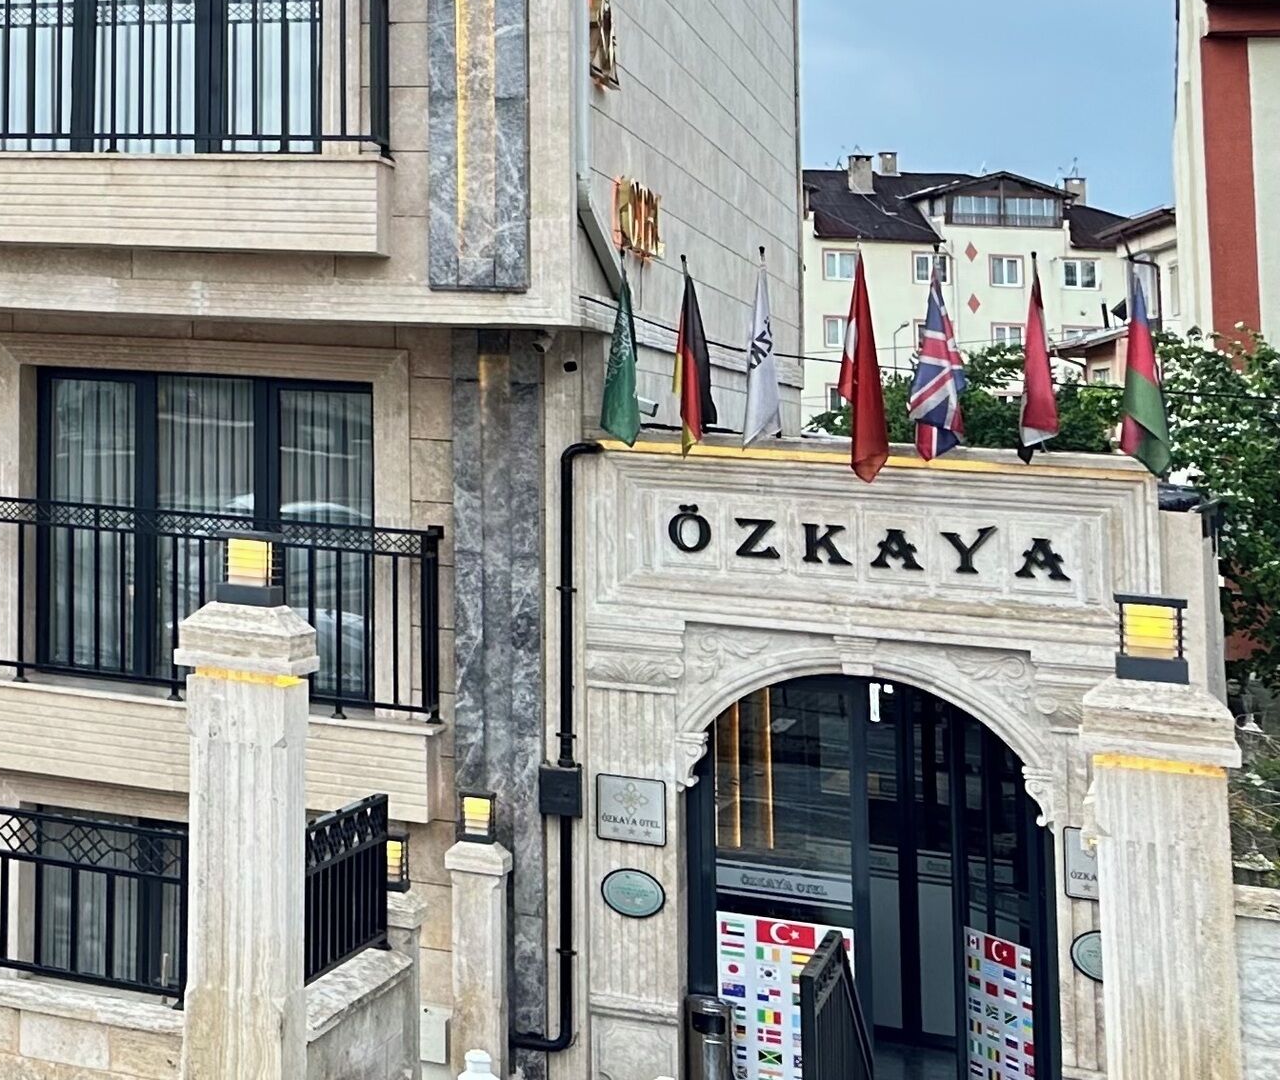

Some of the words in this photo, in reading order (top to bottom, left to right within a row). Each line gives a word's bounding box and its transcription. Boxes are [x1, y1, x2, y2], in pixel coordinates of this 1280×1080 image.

[668, 504, 1071, 581] ÖZKAYA
[601, 812, 638, 826] ÖZKAYA
[639, 818, 661, 829] OTEL
[741, 873, 794, 892] ÖZKAYA
[796, 883, 828, 896] OTEL
